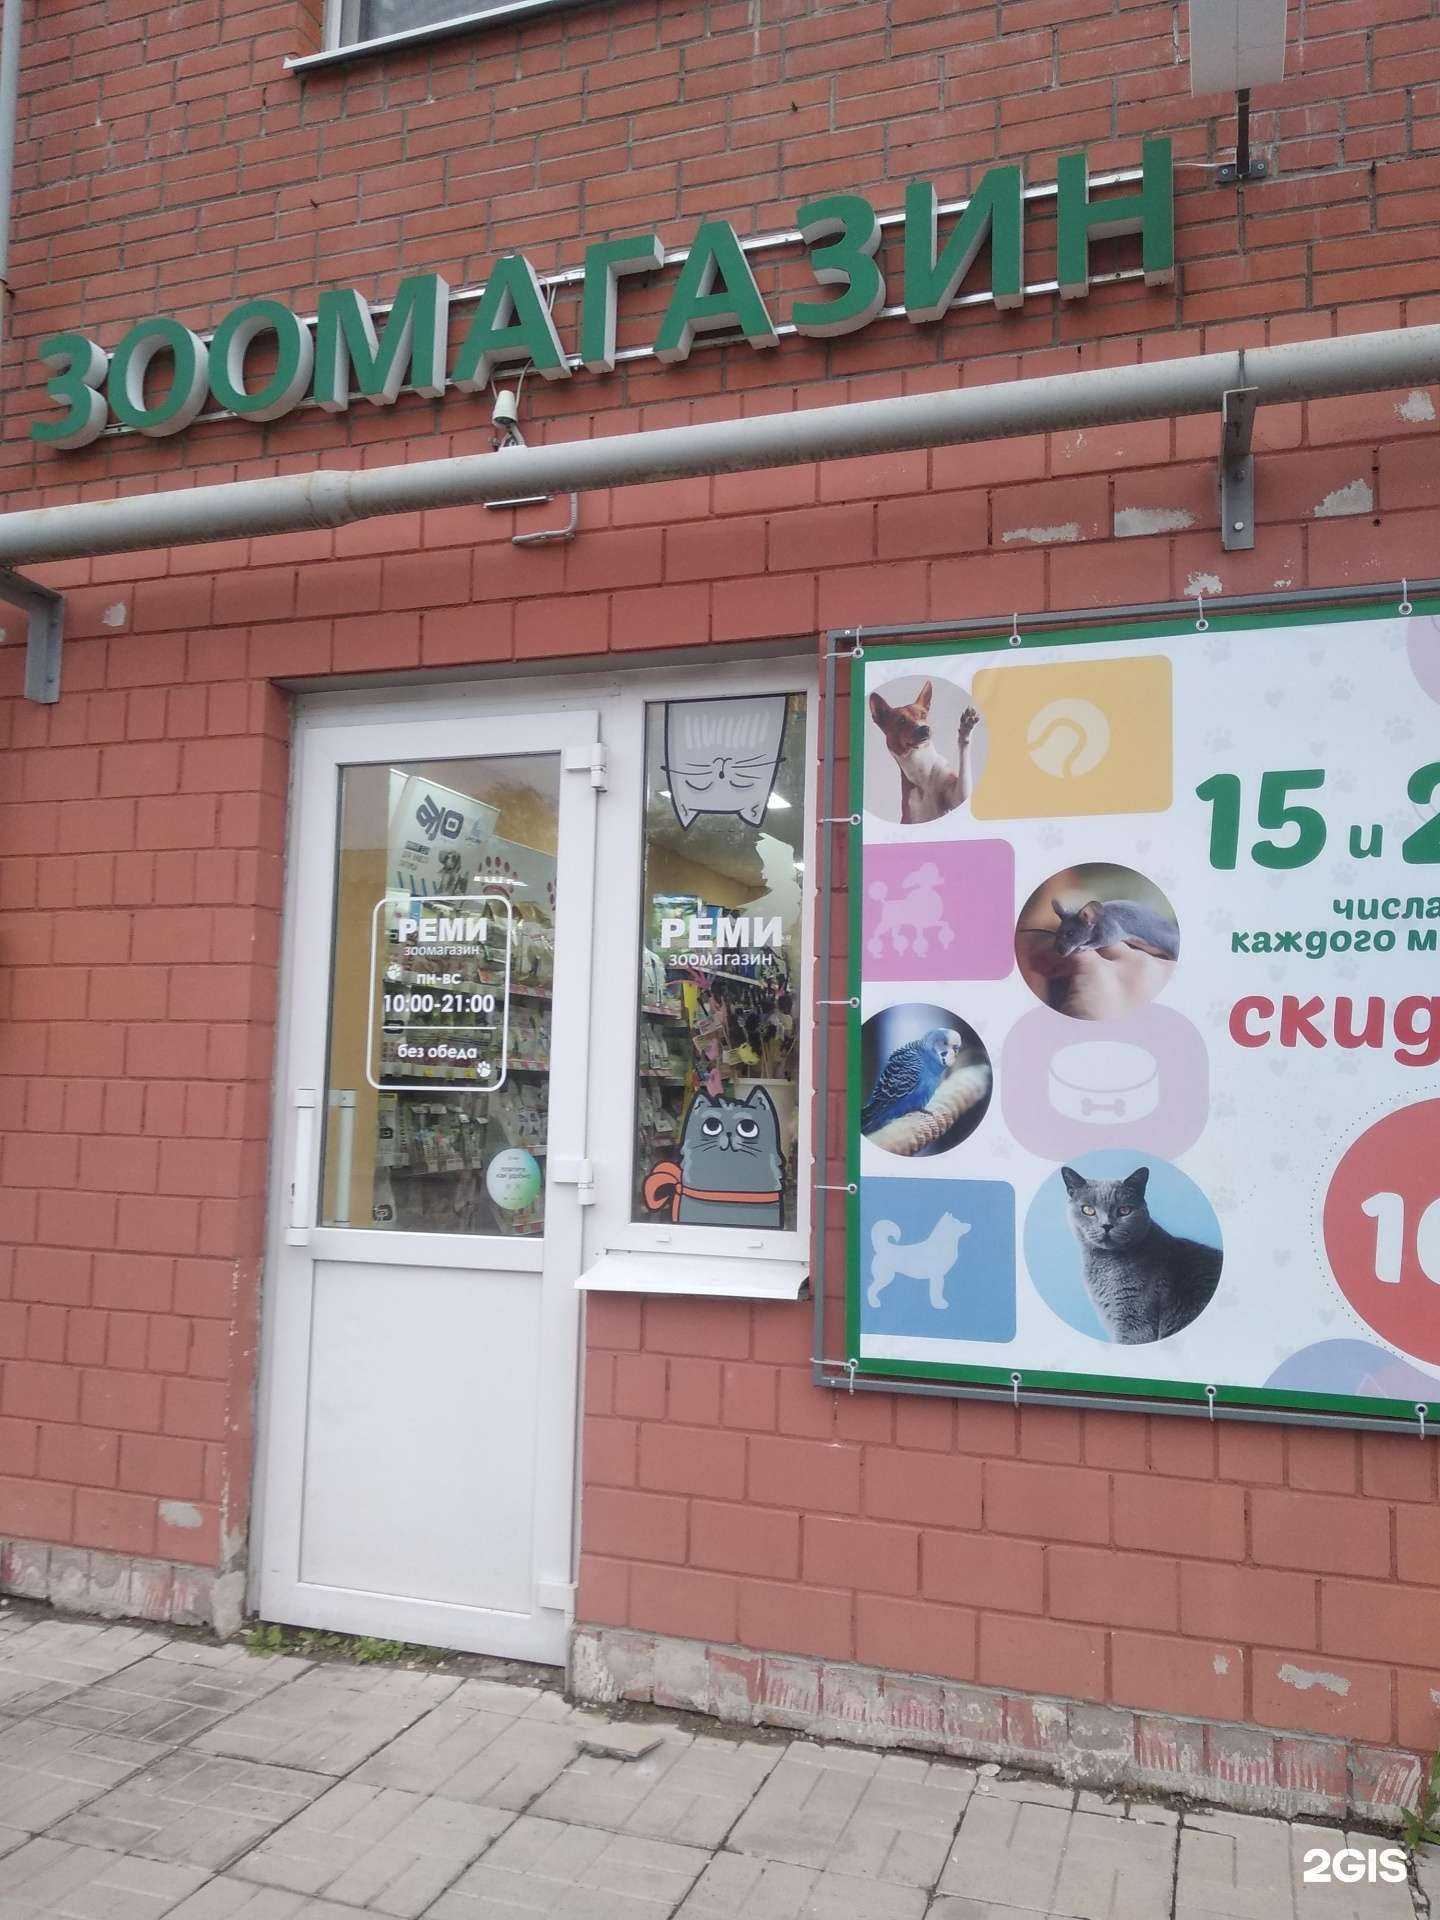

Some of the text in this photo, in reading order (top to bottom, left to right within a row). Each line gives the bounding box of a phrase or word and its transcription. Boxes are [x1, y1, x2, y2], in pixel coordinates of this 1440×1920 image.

[29, 137, 1175, 449] ЗООМАГАЗИН
[1196, 769, 1327, 869] 15
[1350, 824, 1383, 858] и
[1333, 897, 1440, 920] числа
[399, 918, 488, 942] РЕМИ
[661, 916, 783, 948] РЕМИ
[404, 945, 480, 955] зоомагазин
[1231, 930, 1396, 959] каждого
[669, 953, 773, 966] зоомагазин
[383, 994, 495, 1013] 10:00-21:00
[397, 1044, 478, 1060] без обеда
